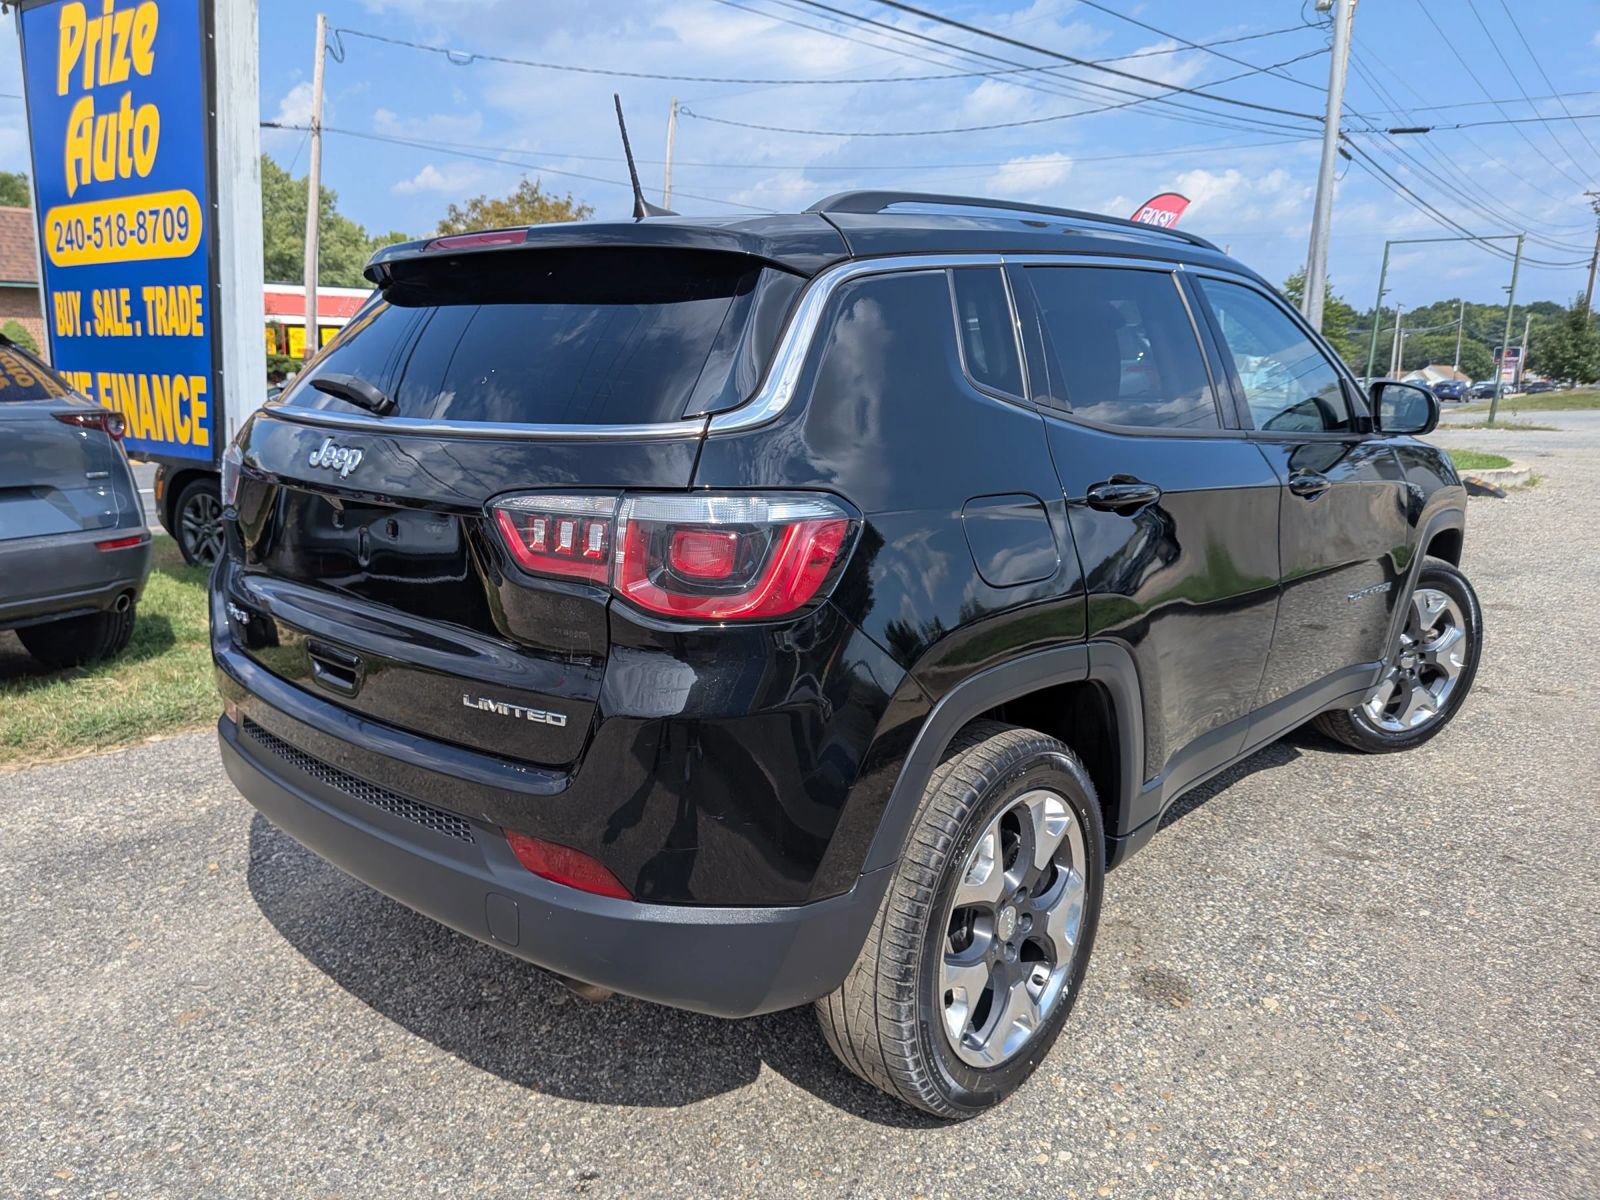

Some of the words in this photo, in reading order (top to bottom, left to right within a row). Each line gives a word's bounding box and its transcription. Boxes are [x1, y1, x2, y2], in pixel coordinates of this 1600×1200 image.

[57, 0, 159, 96] Prize
[65, 90, 161, 199] Auto
[54, 205, 190, 253] 240-518-8709
[143, 285, 204, 337] TRADE
[97, 371, 209, 447] FINANCE
[309, 437, 363, 479] Jeep
[463, 694, 567, 727] LIMITED
